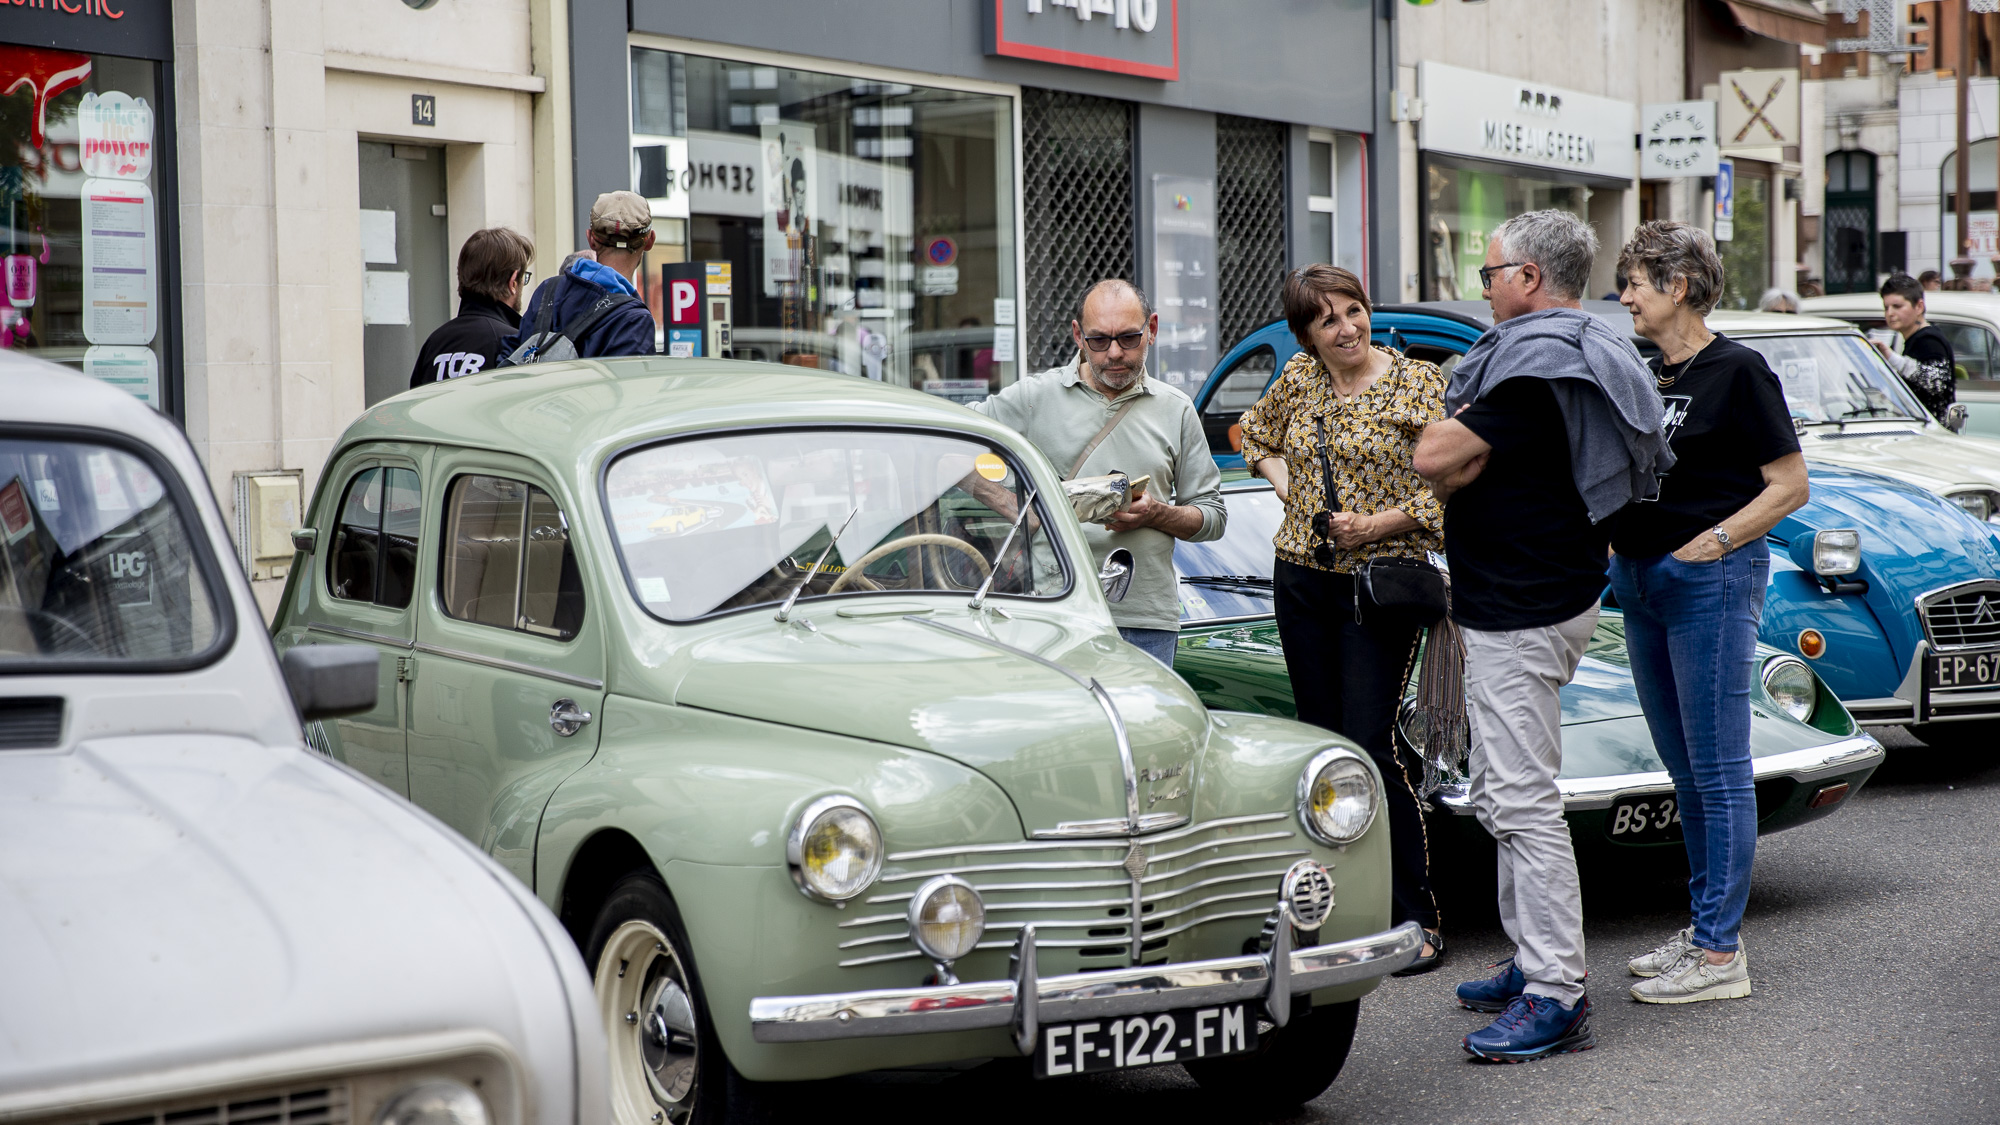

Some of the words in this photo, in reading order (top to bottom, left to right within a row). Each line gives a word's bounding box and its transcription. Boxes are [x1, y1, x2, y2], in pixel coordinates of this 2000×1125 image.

[416, 99, 433, 122] 14
[1651, 109, 1682, 134] MISE
[1686, 113, 1705, 132] AU
[85, 138, 151, 159] power
[1656, 150, 1702, 170] GREEN
[1464, 231, 1485, 256] LES
[672, 282, 696, 322] P
[433, 352, 486, 382] TCB
[109, 551, 147, 579] LPG
[1939, 653, 2000, 685] EP-67
[1046, 1004, 1246, 1077] EF-122-FM
